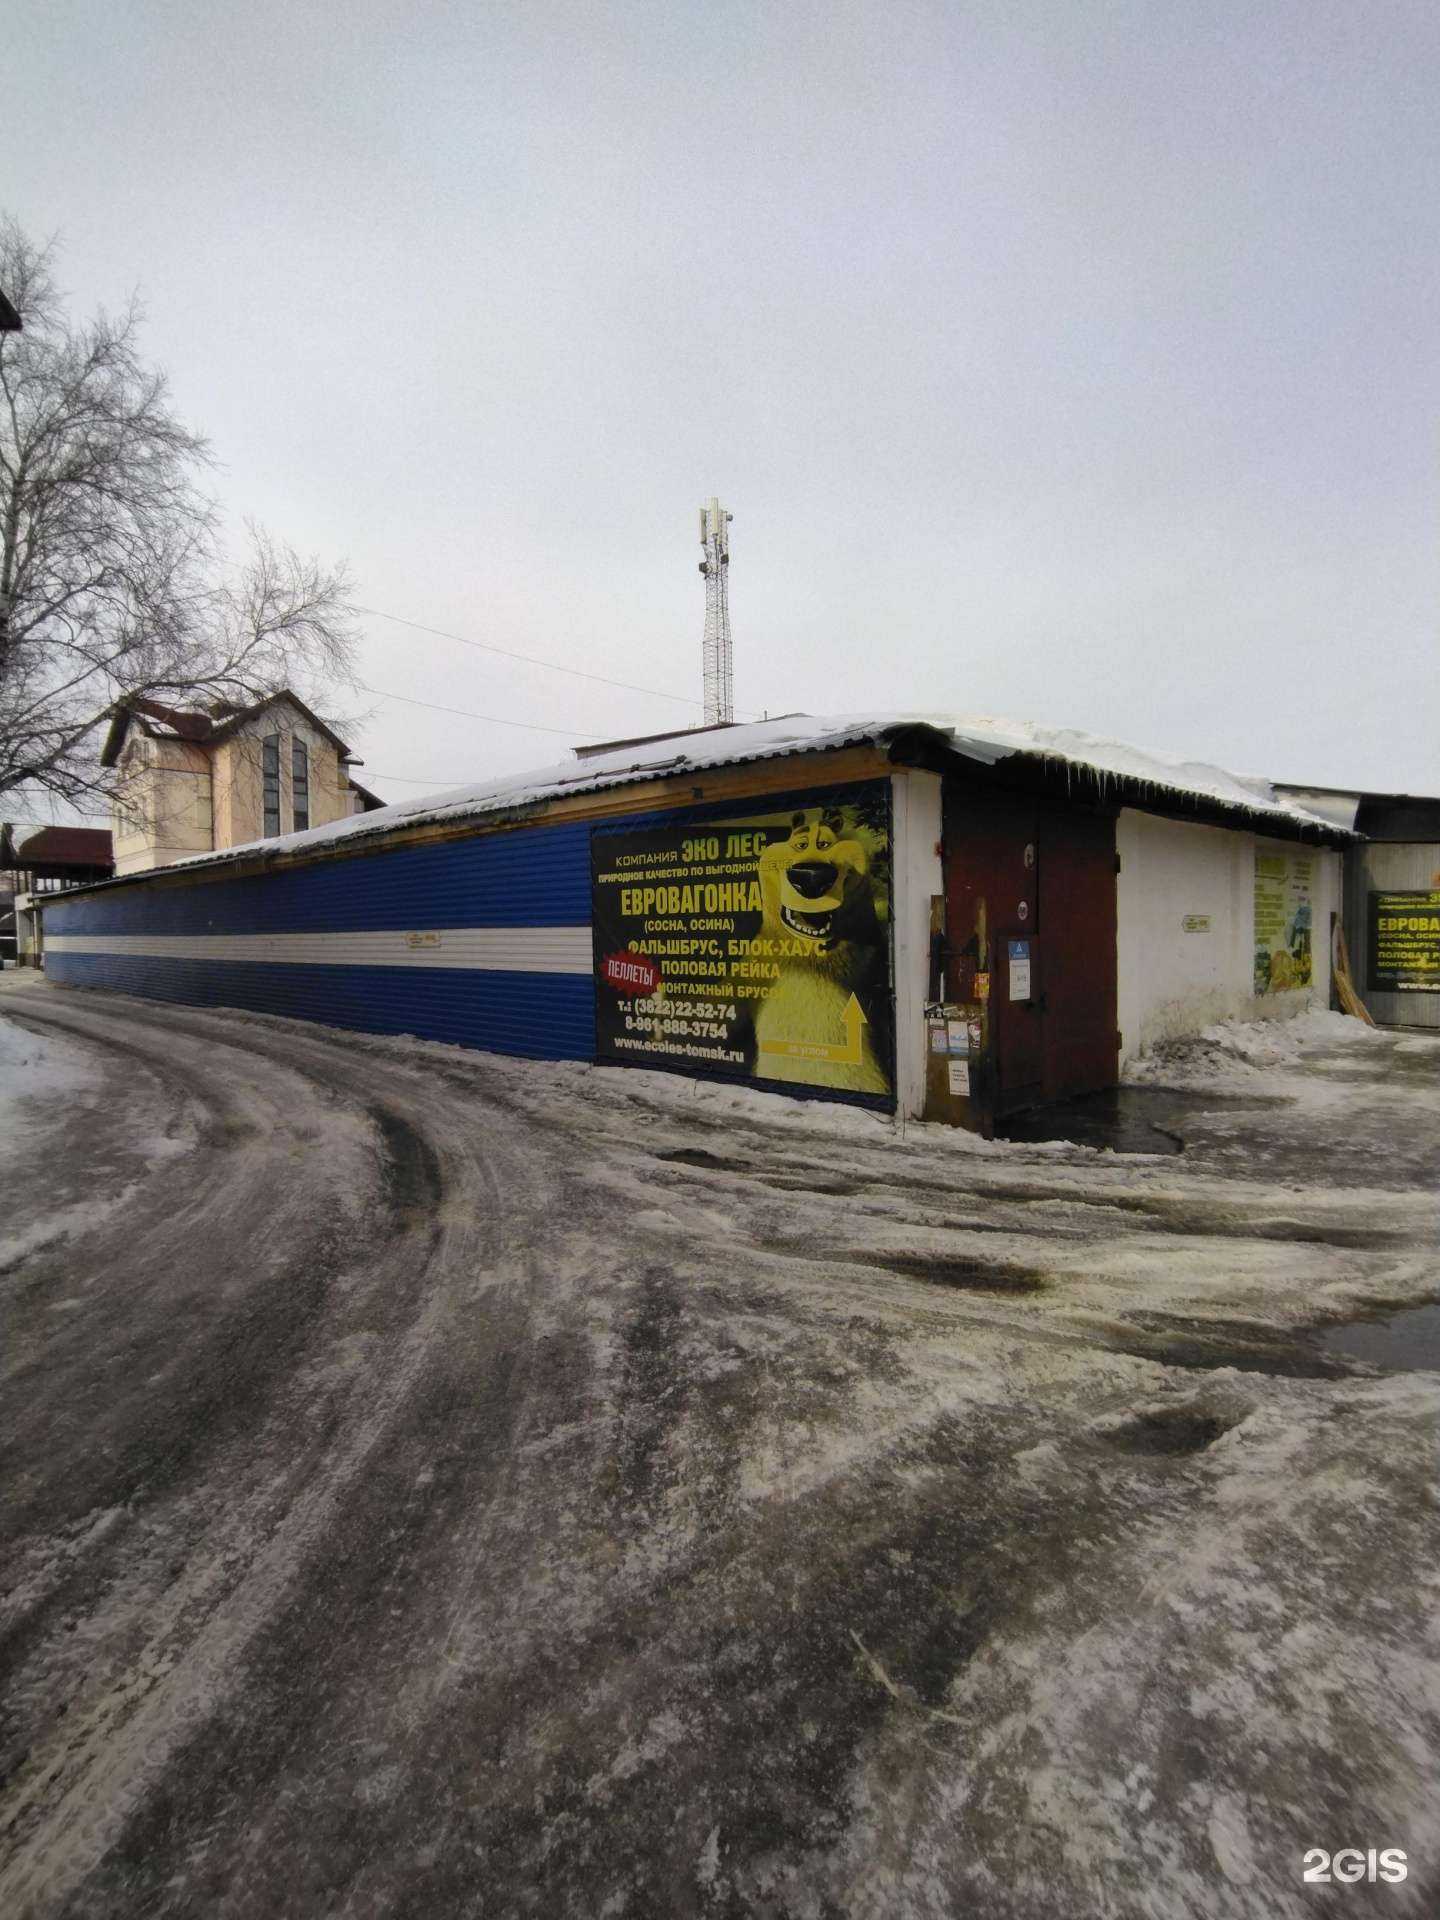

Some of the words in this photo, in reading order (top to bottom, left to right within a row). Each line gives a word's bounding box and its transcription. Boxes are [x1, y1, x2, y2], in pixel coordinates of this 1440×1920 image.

[615, 851, 678, 867] КОМПАНИЯ
[682, 838, 719, 862] ЭКО
[725, 832, 767, 859] ЛЕС
[598, 871, 643, 884] ПРИРОДНОЕ
[645, 867, 688, 881] КАЧЕСТВО
[690, 866, 703, 877] ПО
[705, 861, 761, 876] ВЫГОДНОЙ
[621, 881, 763, 915] ЕВРОВАГОНКА
[644, 919, 687, 933] (СОСНА,
[690, 918, 735, 933] ОСИНА)
[628, 939, 723, 959] ФАЛЬШБРУС,
[728, 939, 827, 957] БЛОК-ХАУС
[608, 959, 654, 986] ПЕЛЛЕТЫ
[661, 960, 727, 977] ПОЛОВАЯ
[731, 960, 780, 979] РЕЙКА
[657, 982, 734, 998] МОНТАЖНЫЙ
[634, 998, 736, 1020] (3822)22-52-74
[614, 1038, 745, 1063] www.ecoles-tomsk.ru
